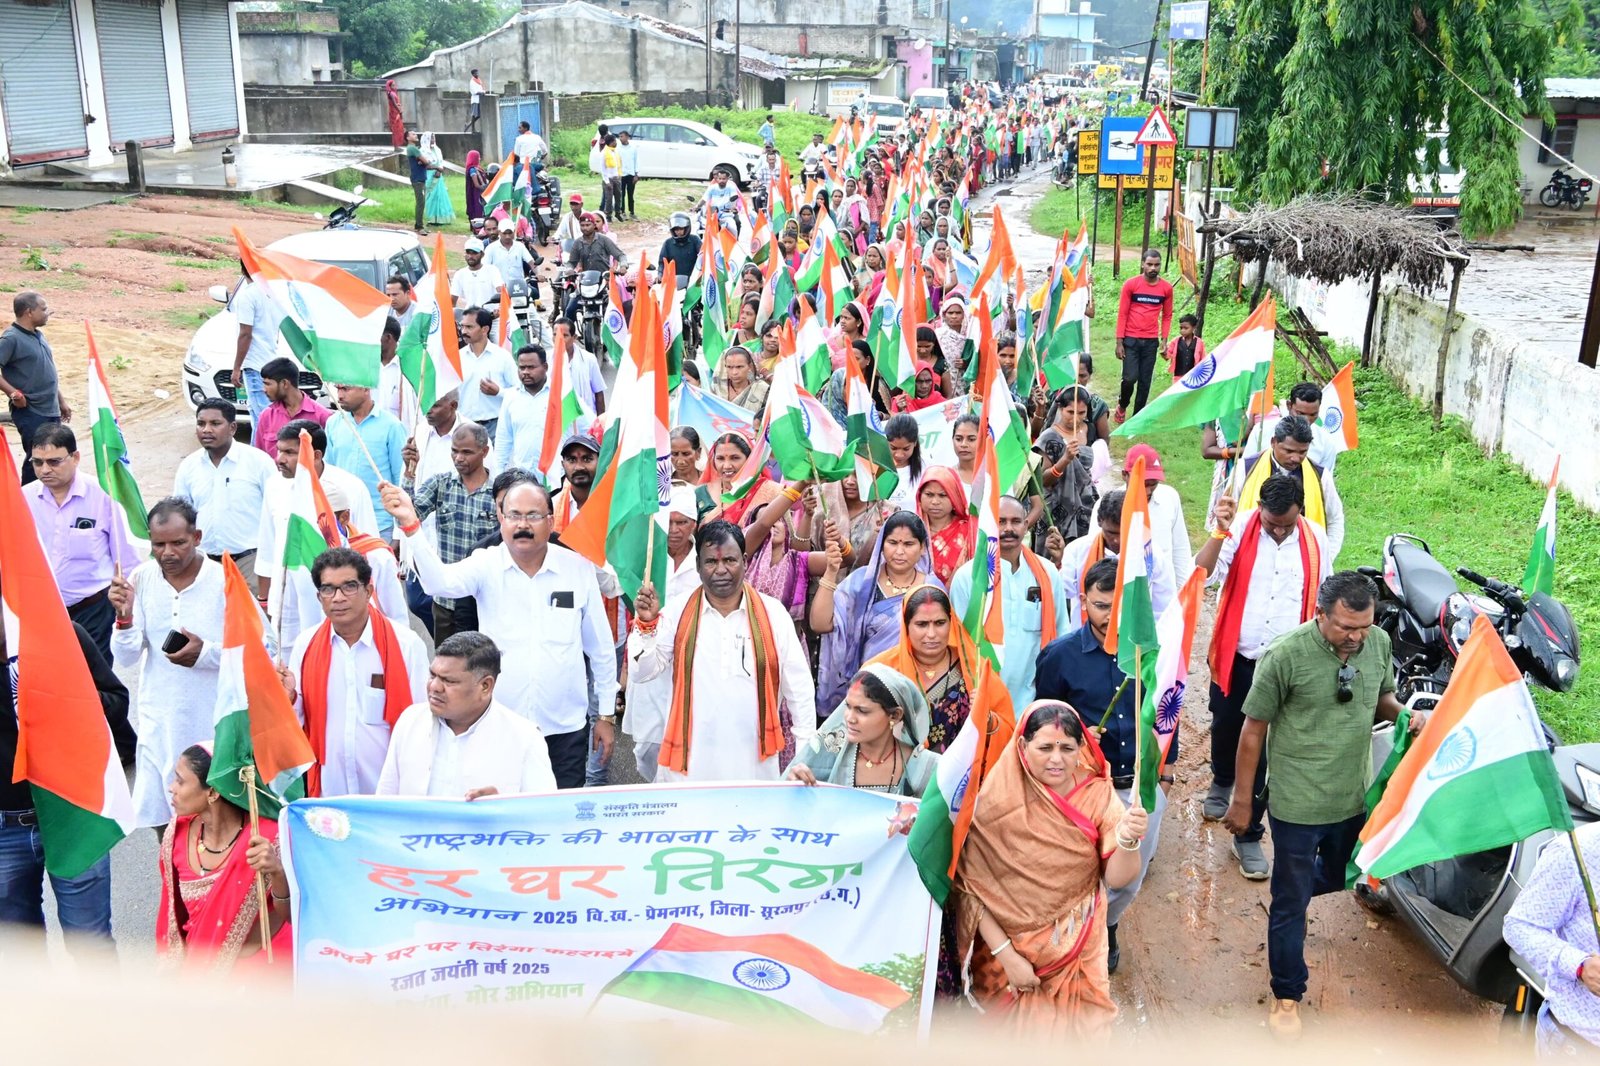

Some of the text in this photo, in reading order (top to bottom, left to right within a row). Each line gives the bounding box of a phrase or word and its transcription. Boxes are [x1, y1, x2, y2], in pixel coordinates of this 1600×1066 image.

[603, 803, 639, 812] संस्कृति
[400, 824, 840, 852] राष्ट्रभक्ति की भावना के साथ
[357, 846, 863, 901] हर घर तिरंगा
[374, 897, 529, 922] अभियान
[533, 910, 578, 924] 2025
[319, 946, 378, 965] अपने
[385, 945, 421, 961] घर
[424, 941, 461, 951] पर
[467, 941, 536, 952] तिरंगा
[390, 958, 550, 992] रजत जयंती वर्ष 2025
[504, 981, 585, 1001] अभियान
